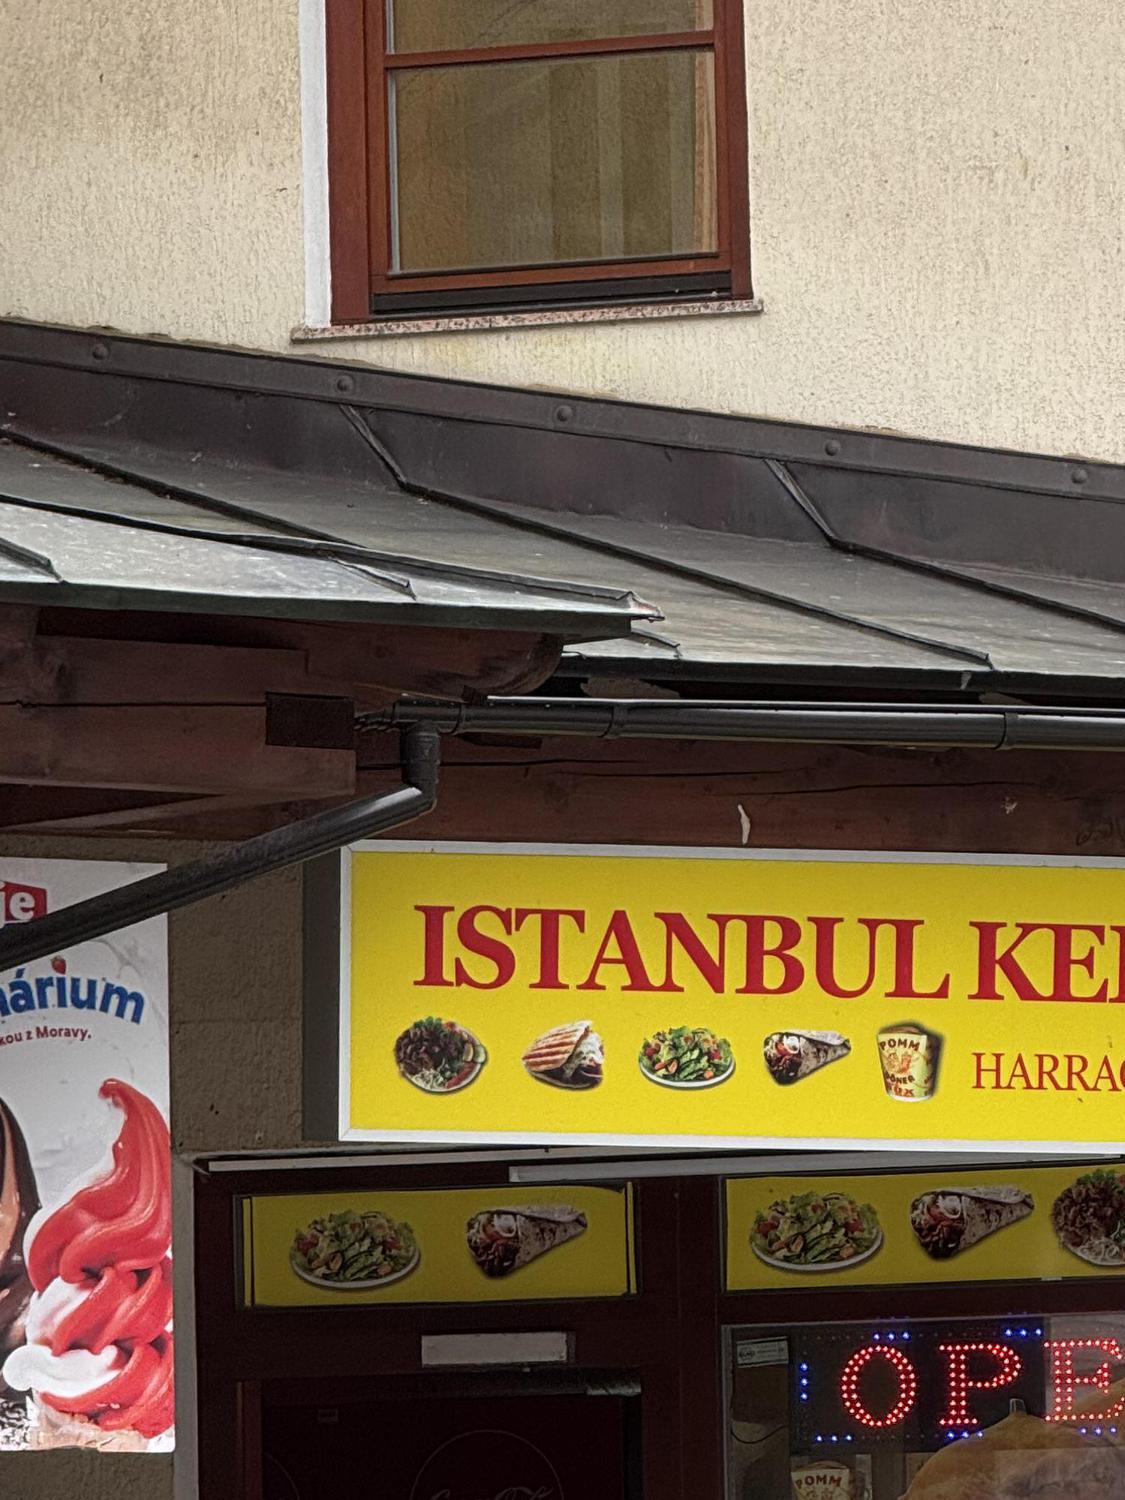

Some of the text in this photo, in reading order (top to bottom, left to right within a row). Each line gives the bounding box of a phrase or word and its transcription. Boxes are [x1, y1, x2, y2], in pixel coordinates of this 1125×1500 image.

[413, 904, 951, 1000] ISTANBUL
[36, 1025, 92, 1042] Moravy.
[795, 1475, 842, 1490] POMM
